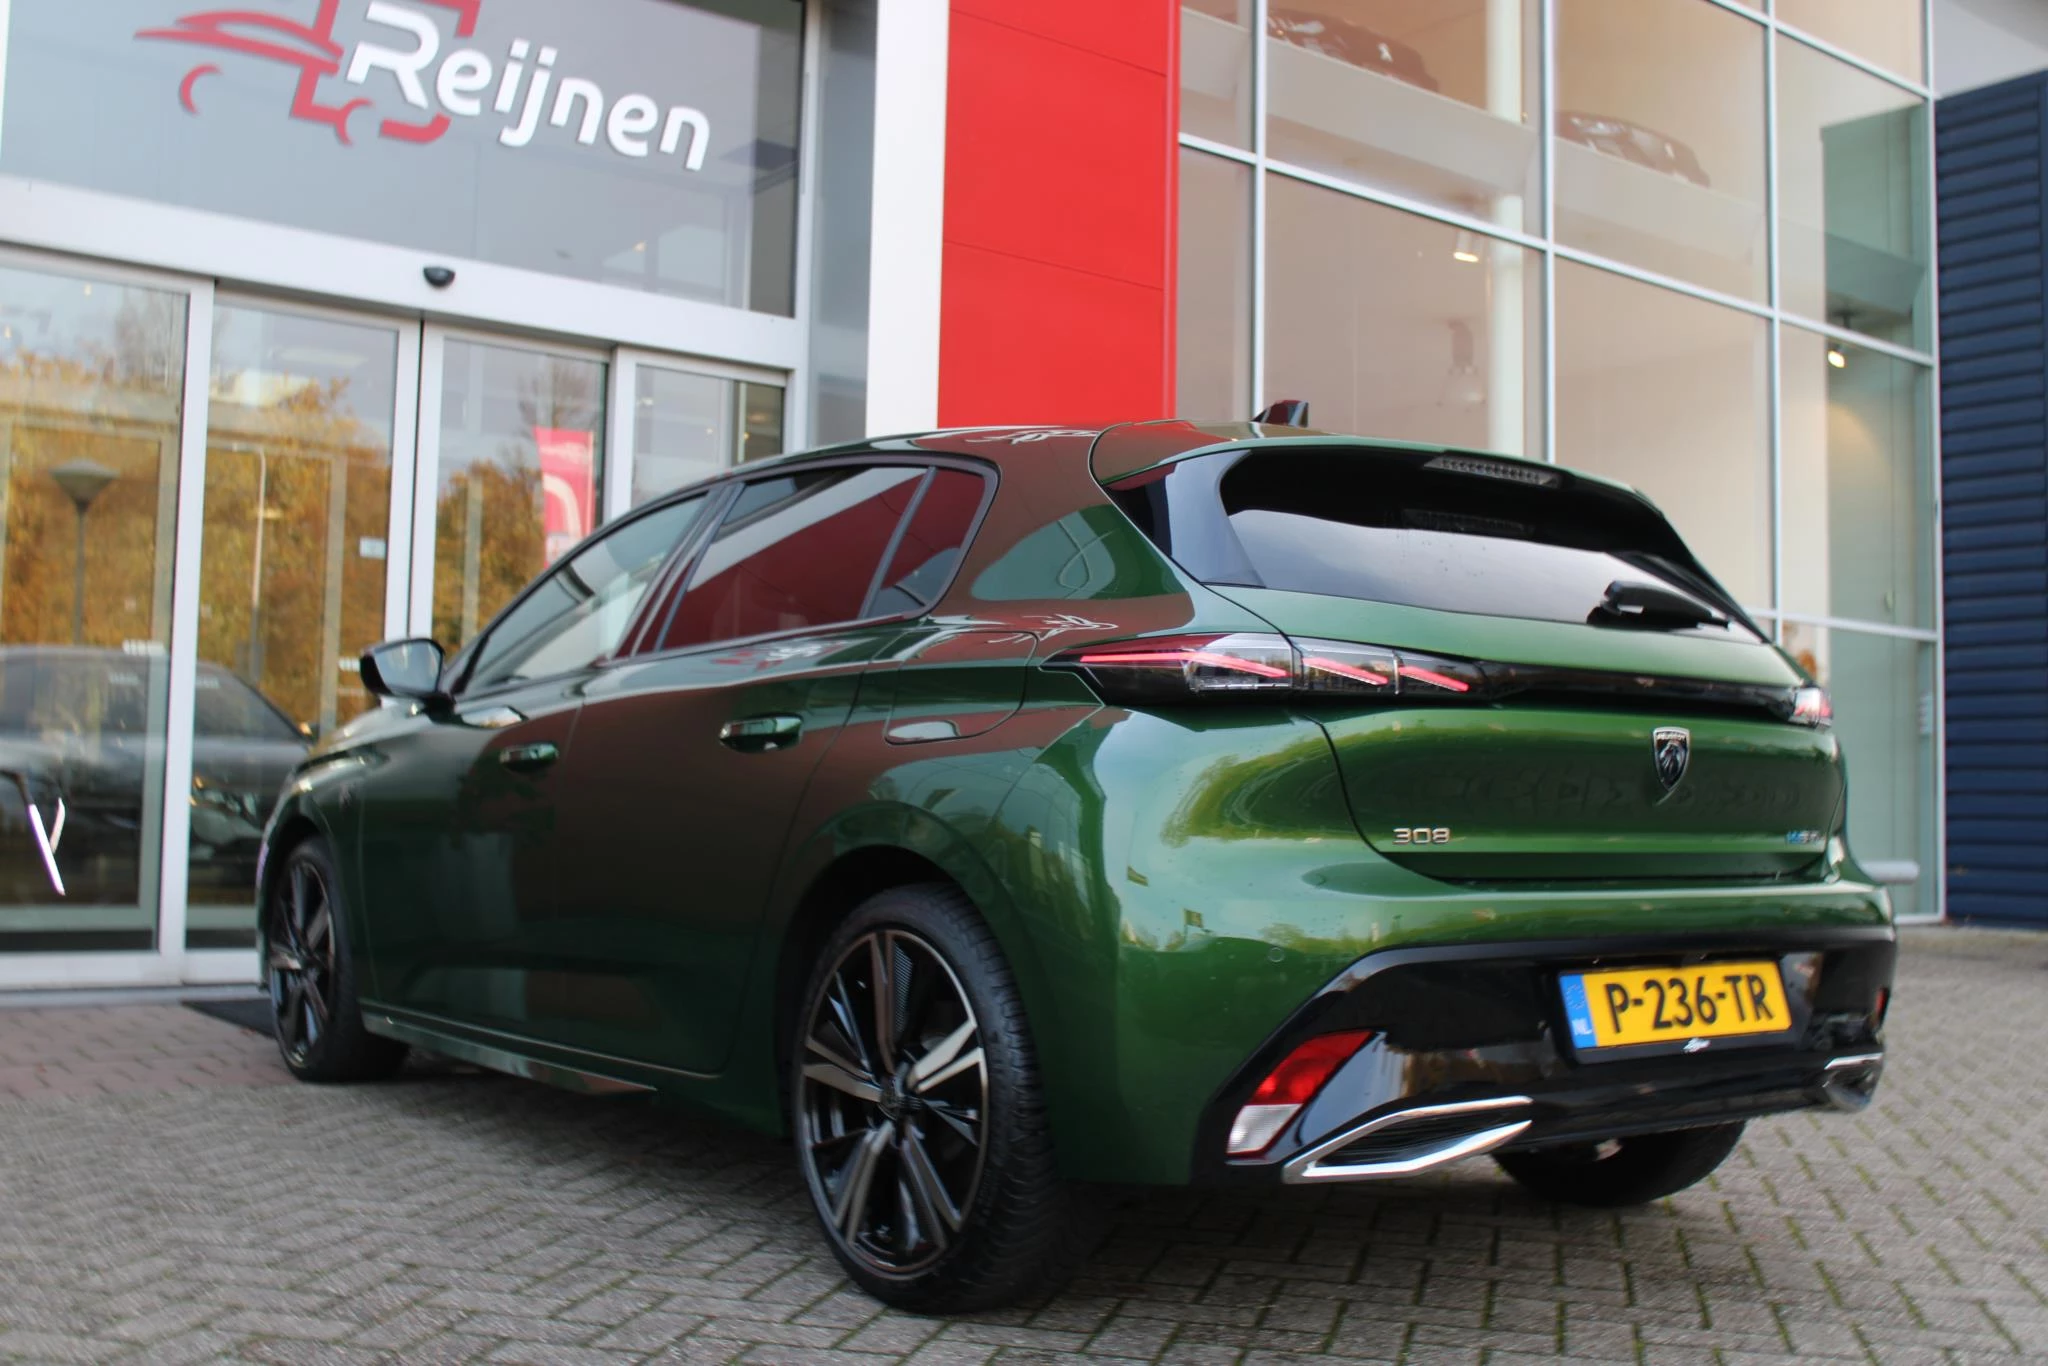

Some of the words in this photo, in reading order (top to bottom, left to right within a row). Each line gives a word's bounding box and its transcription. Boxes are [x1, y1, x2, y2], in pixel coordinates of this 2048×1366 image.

[347, 2, 711, 171] Reijnen
[1393, 827, 1450, 844] 308
[1604, 973, 1774, 1034] P-236-TR
